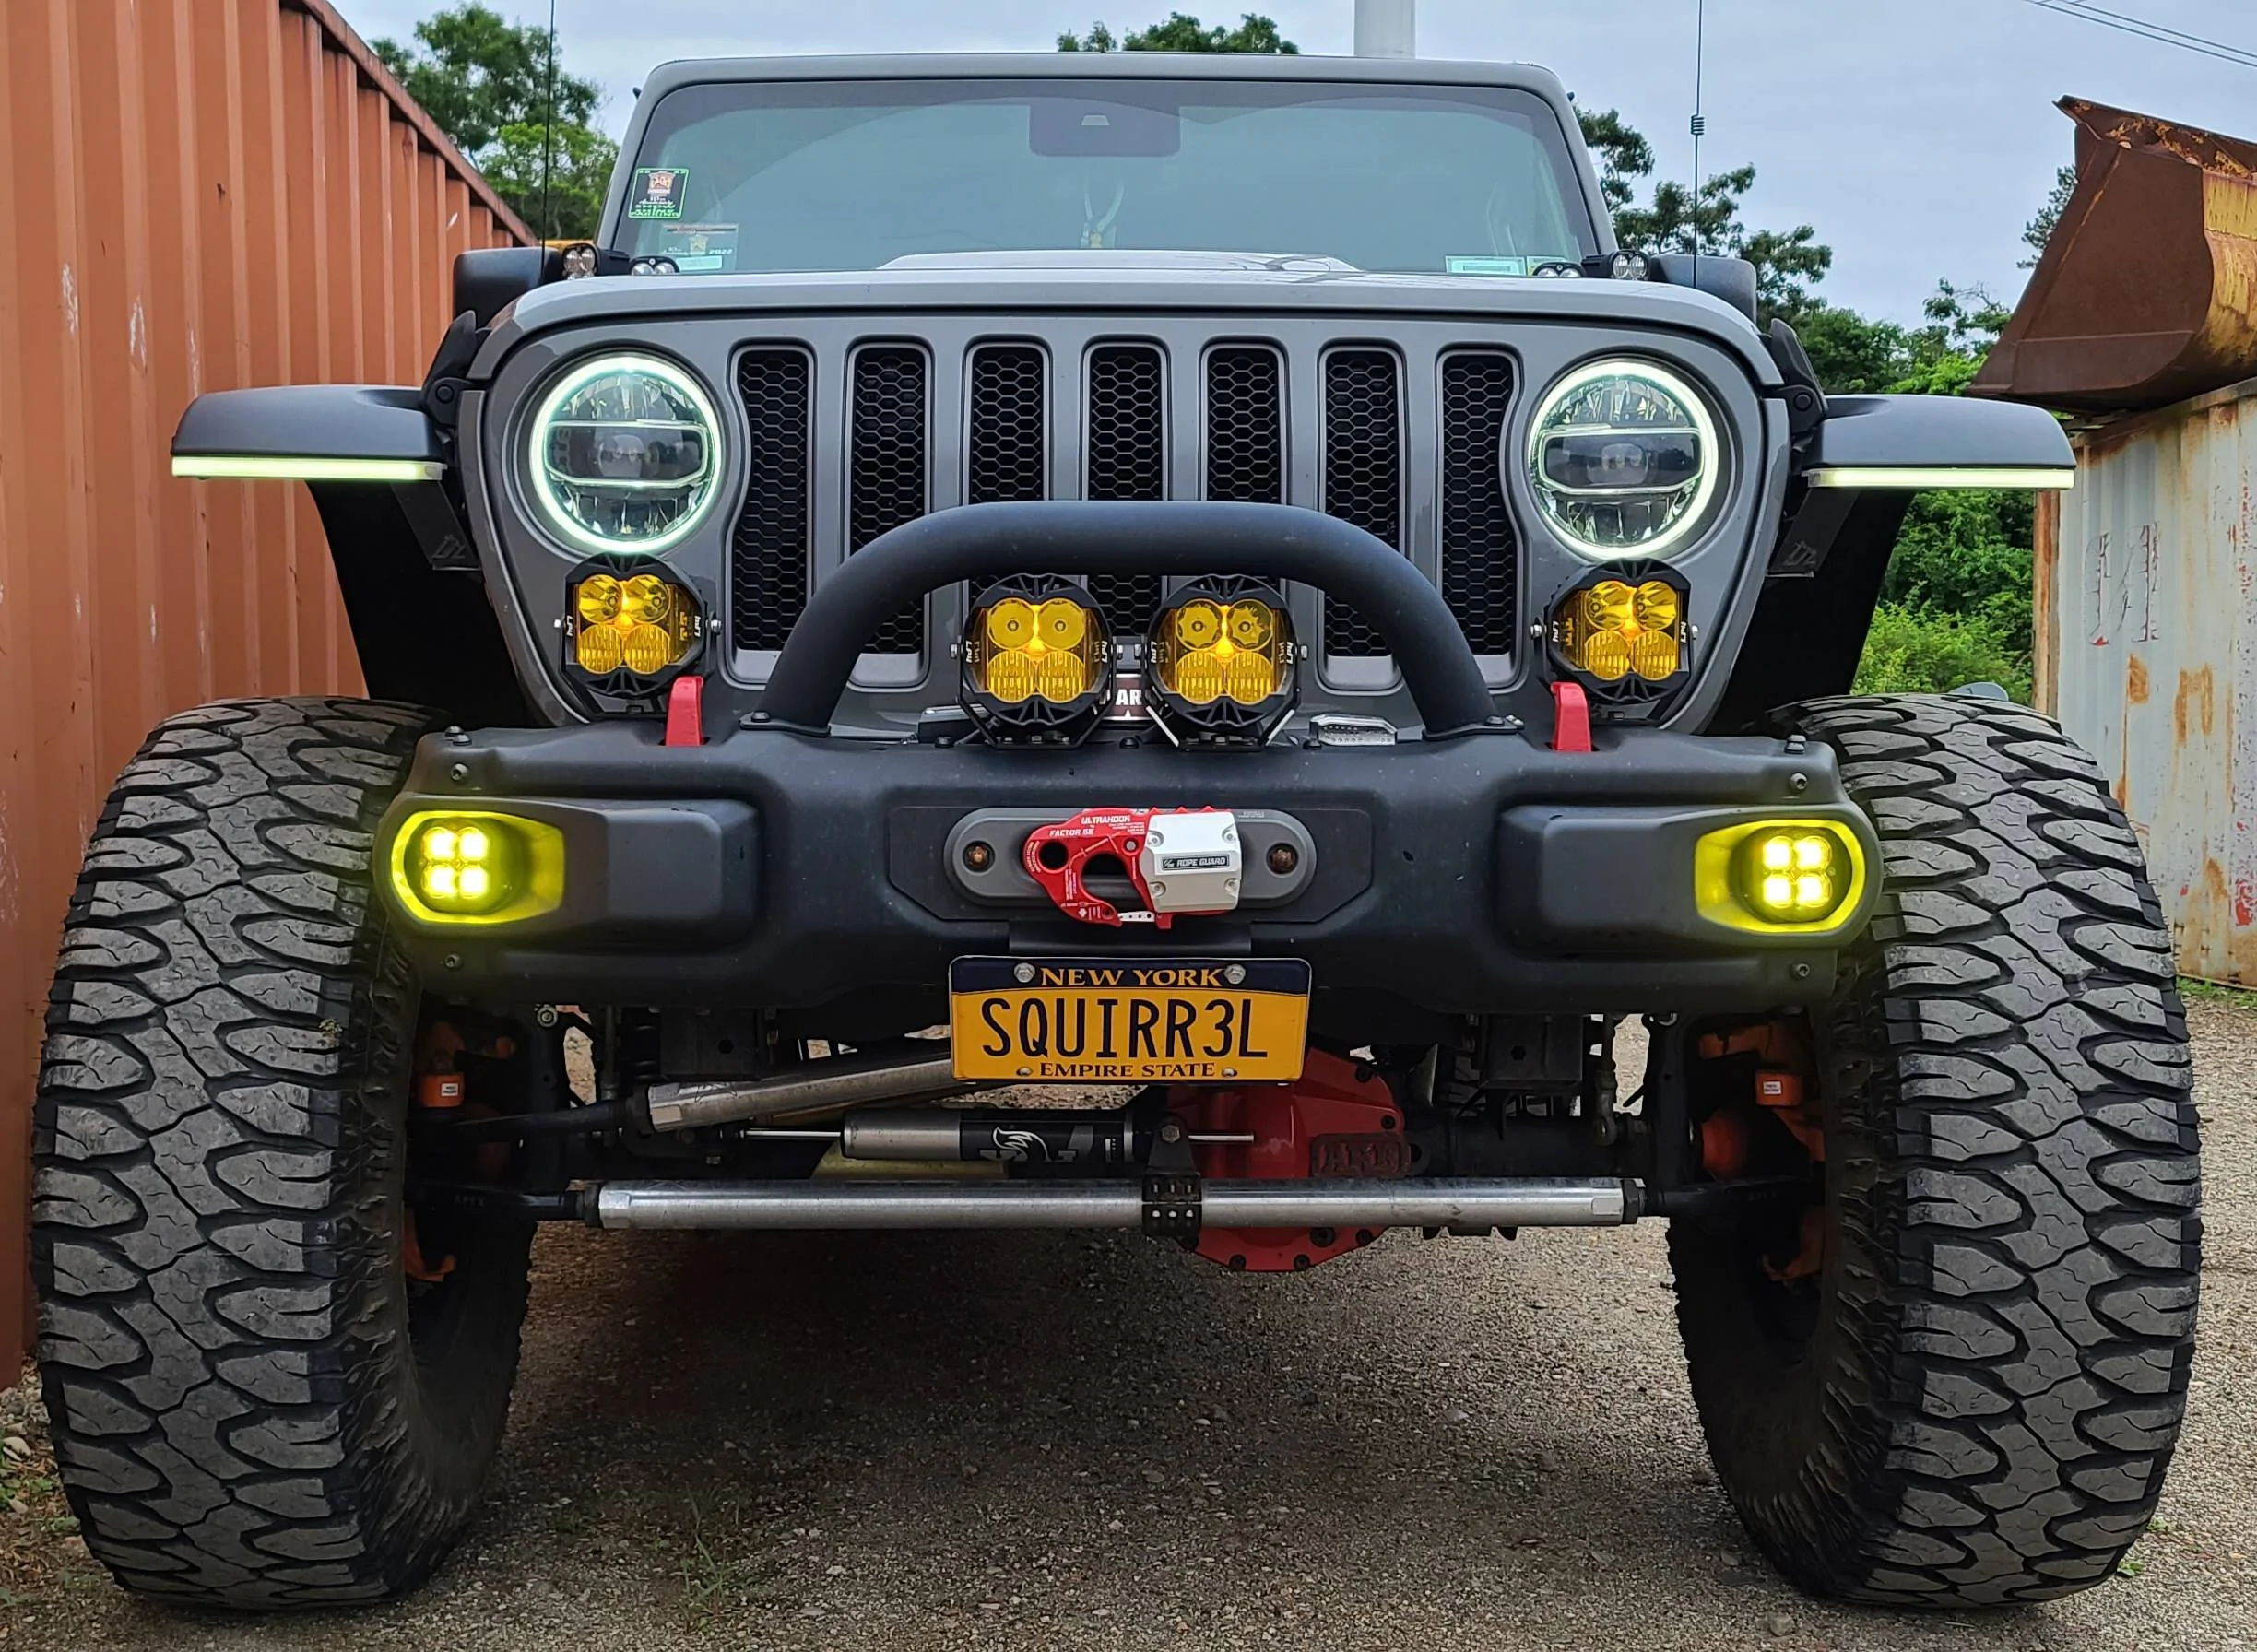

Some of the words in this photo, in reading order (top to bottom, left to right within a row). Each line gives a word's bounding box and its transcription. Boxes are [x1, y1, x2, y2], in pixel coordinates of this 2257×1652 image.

[1081, 815, 1131, 824] ULTRAHOOK
[1049, 828, 1080, 837] FACTOR
[1176, 858, 1198, 867] ROPE
[1199, 857, 1225, 867] GUARD
[1040, 968, 1127, 986] NEW
[1133, 968, 1223, 986] YORK
[981, 997, 1268, 1058] SQUIRR3L
[1039, 1062, 1133, 1078] EMPIRE
[1141, 1062, 1215, 1078] STATE
